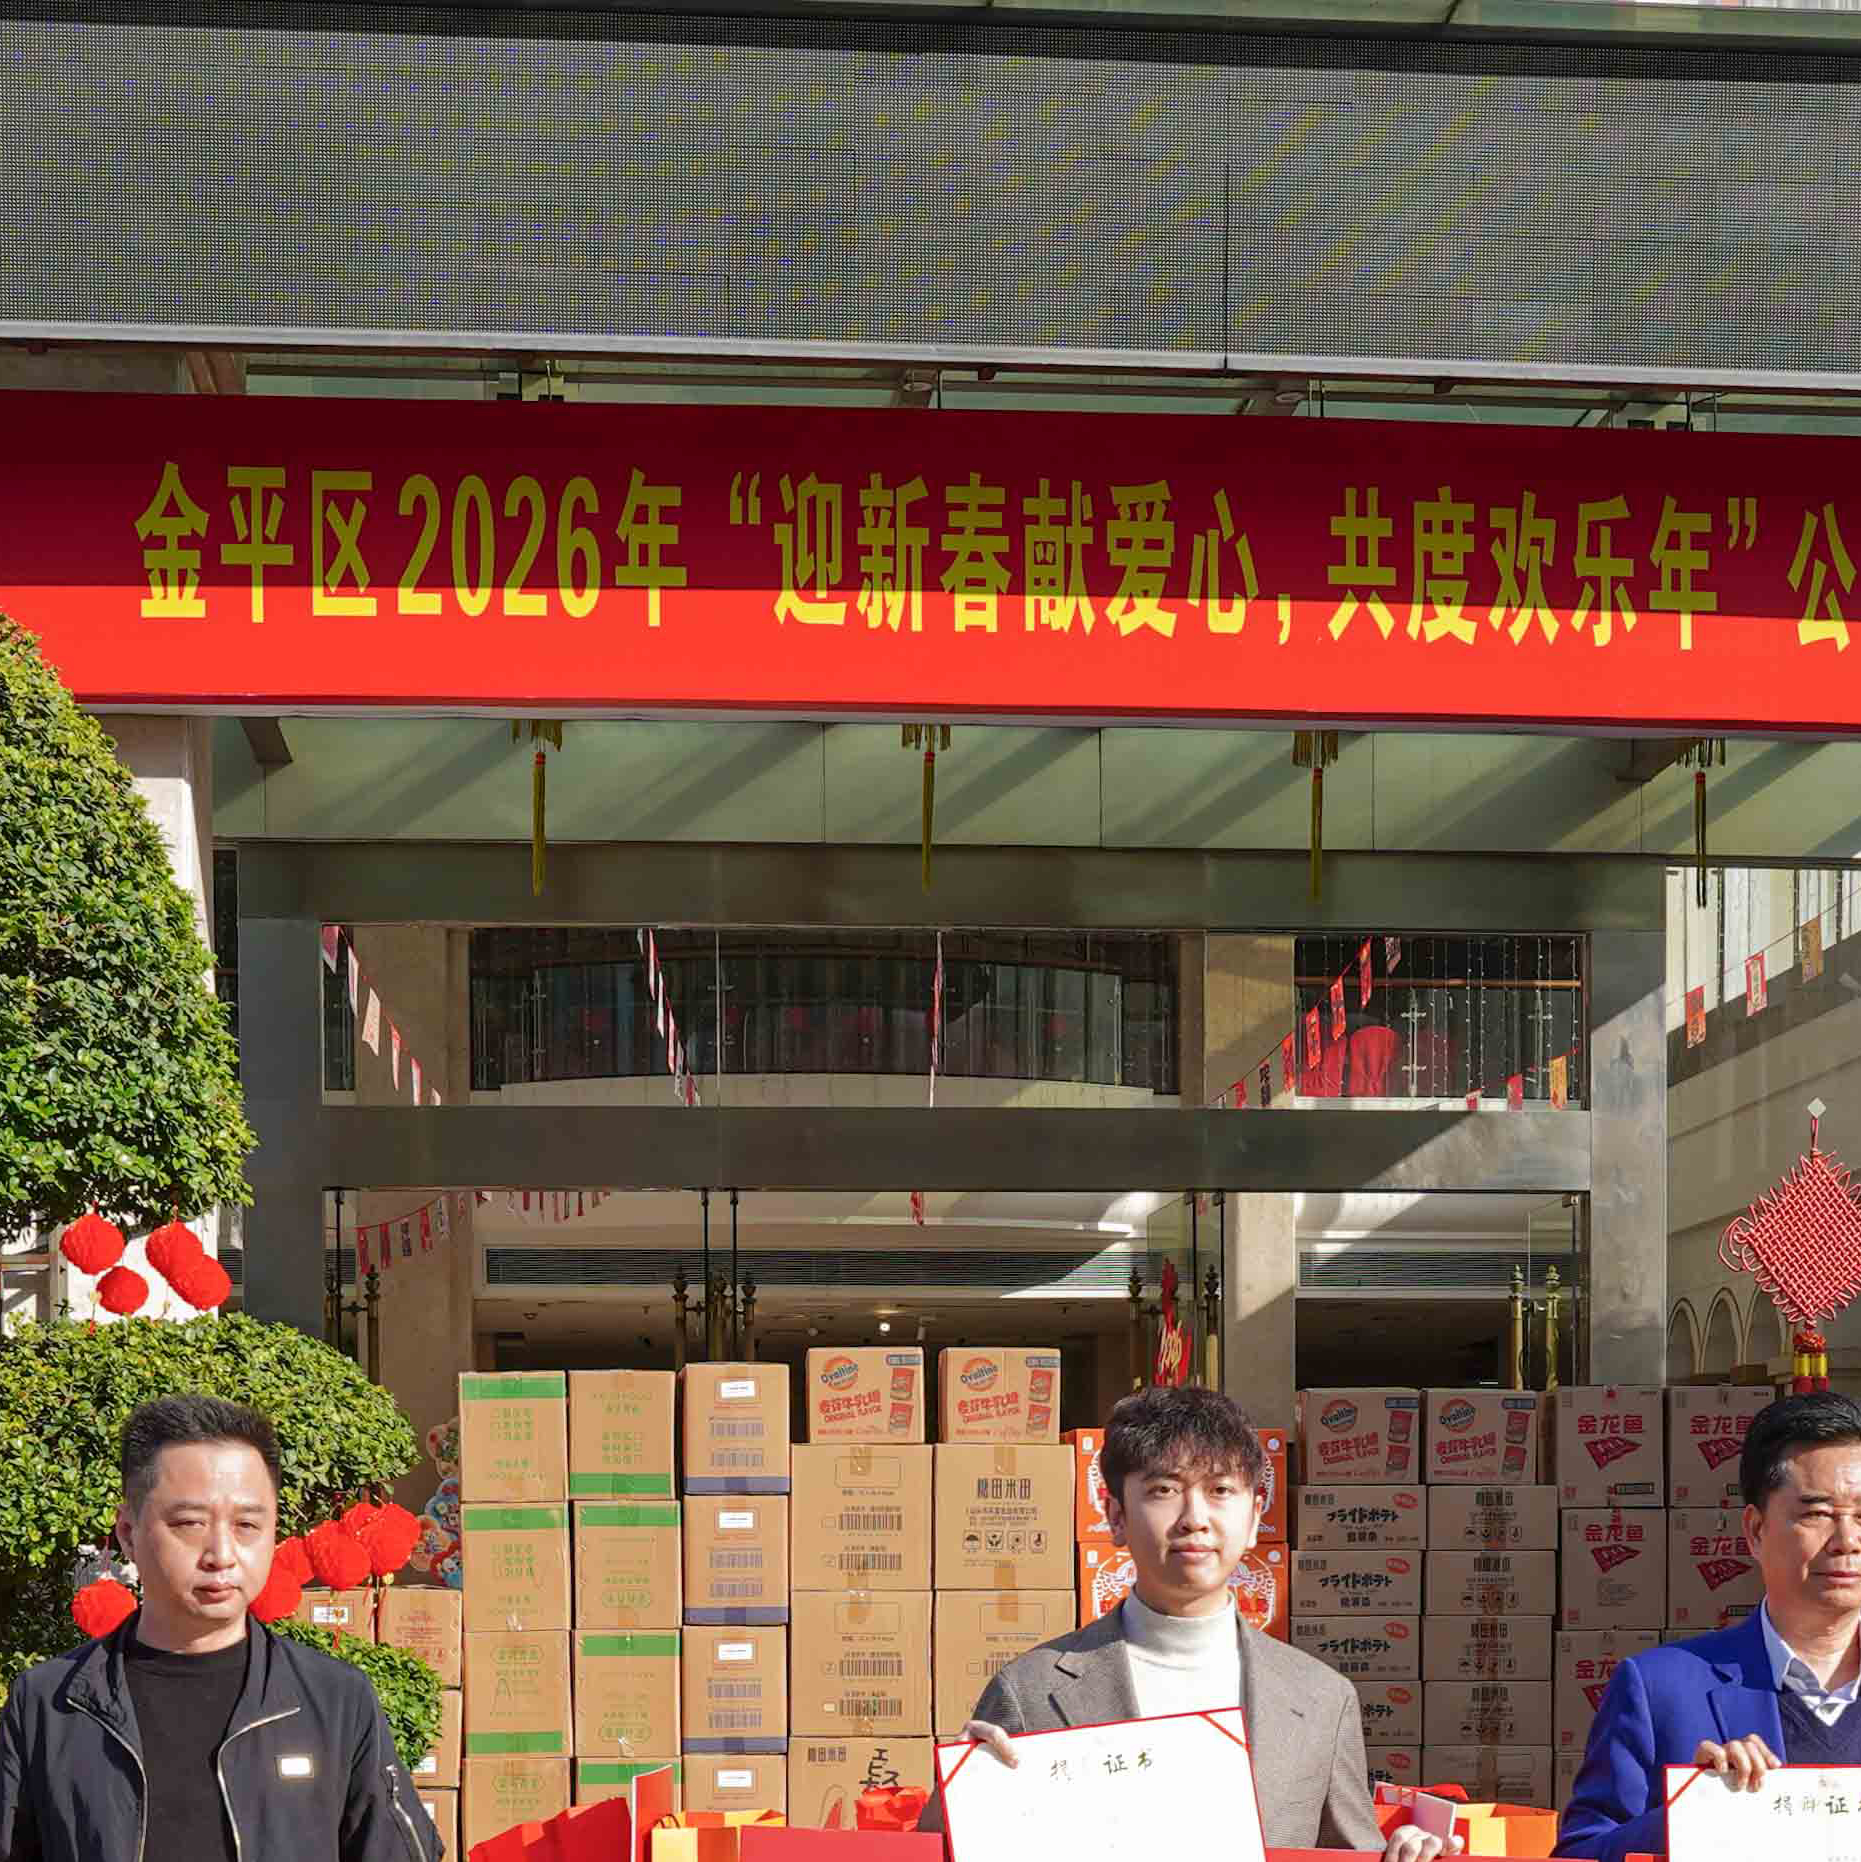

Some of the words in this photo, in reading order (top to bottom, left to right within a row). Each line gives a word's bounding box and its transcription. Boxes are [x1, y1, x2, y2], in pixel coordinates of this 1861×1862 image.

[1577, 1414, 1644, 1435] 金龙鱼
[1690, 1415, 1754, 1435] 金龙鱼
[1585, 1524, 1644, 1542] 金龙鱼
[1049, 1750, 1154, 1779] 捐证书
